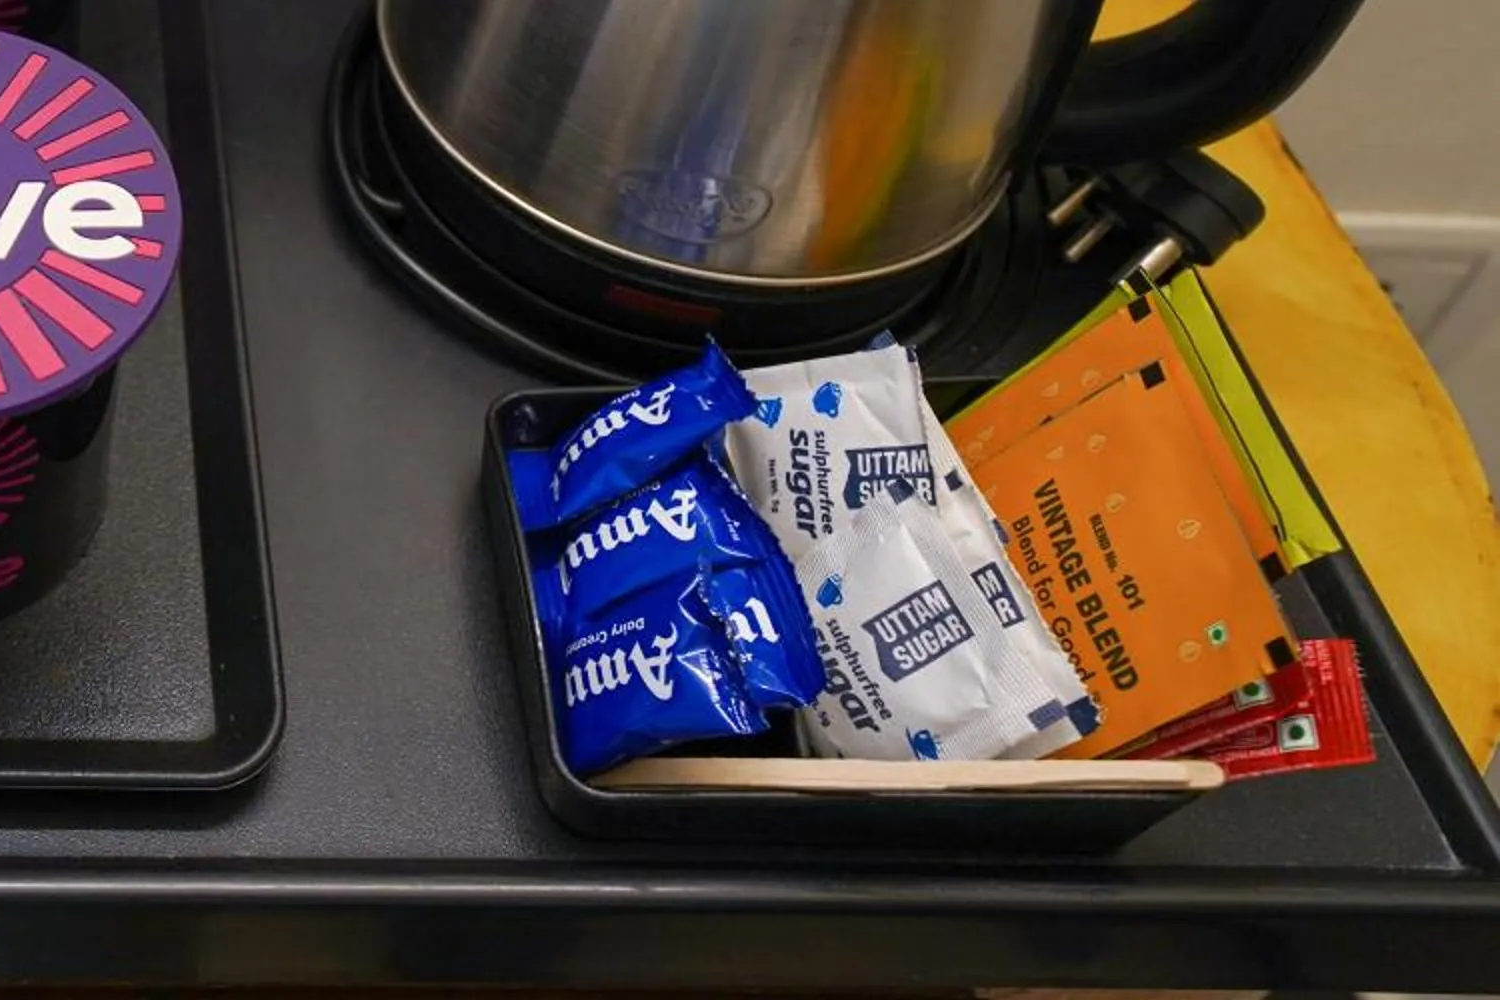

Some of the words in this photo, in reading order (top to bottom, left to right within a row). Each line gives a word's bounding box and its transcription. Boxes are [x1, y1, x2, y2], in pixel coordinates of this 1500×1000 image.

[786, 428, 818, 540] sugar
[811, 430, 835, 535] sulphurfree
[857, 449, 930, 477] UTTAM
[557, 479, 698, 596] Amul
[1012, 515, 1048, 576] Blend
[1033, 576, 1057, 611] for
[611, 617, 646, 638] Dairy
[874, 585, 951, 643] UTTAM
[1033, 478, 1092, 594] VINTAGE
[1075, 592, 1140, 692] BLEND
[1117, 574, 1146, 611] 101
[565, 621, 678, 708] Amu
[825, 617, 893, 721] sulphurfree
[892, 614, 968, 671] SUGAR
